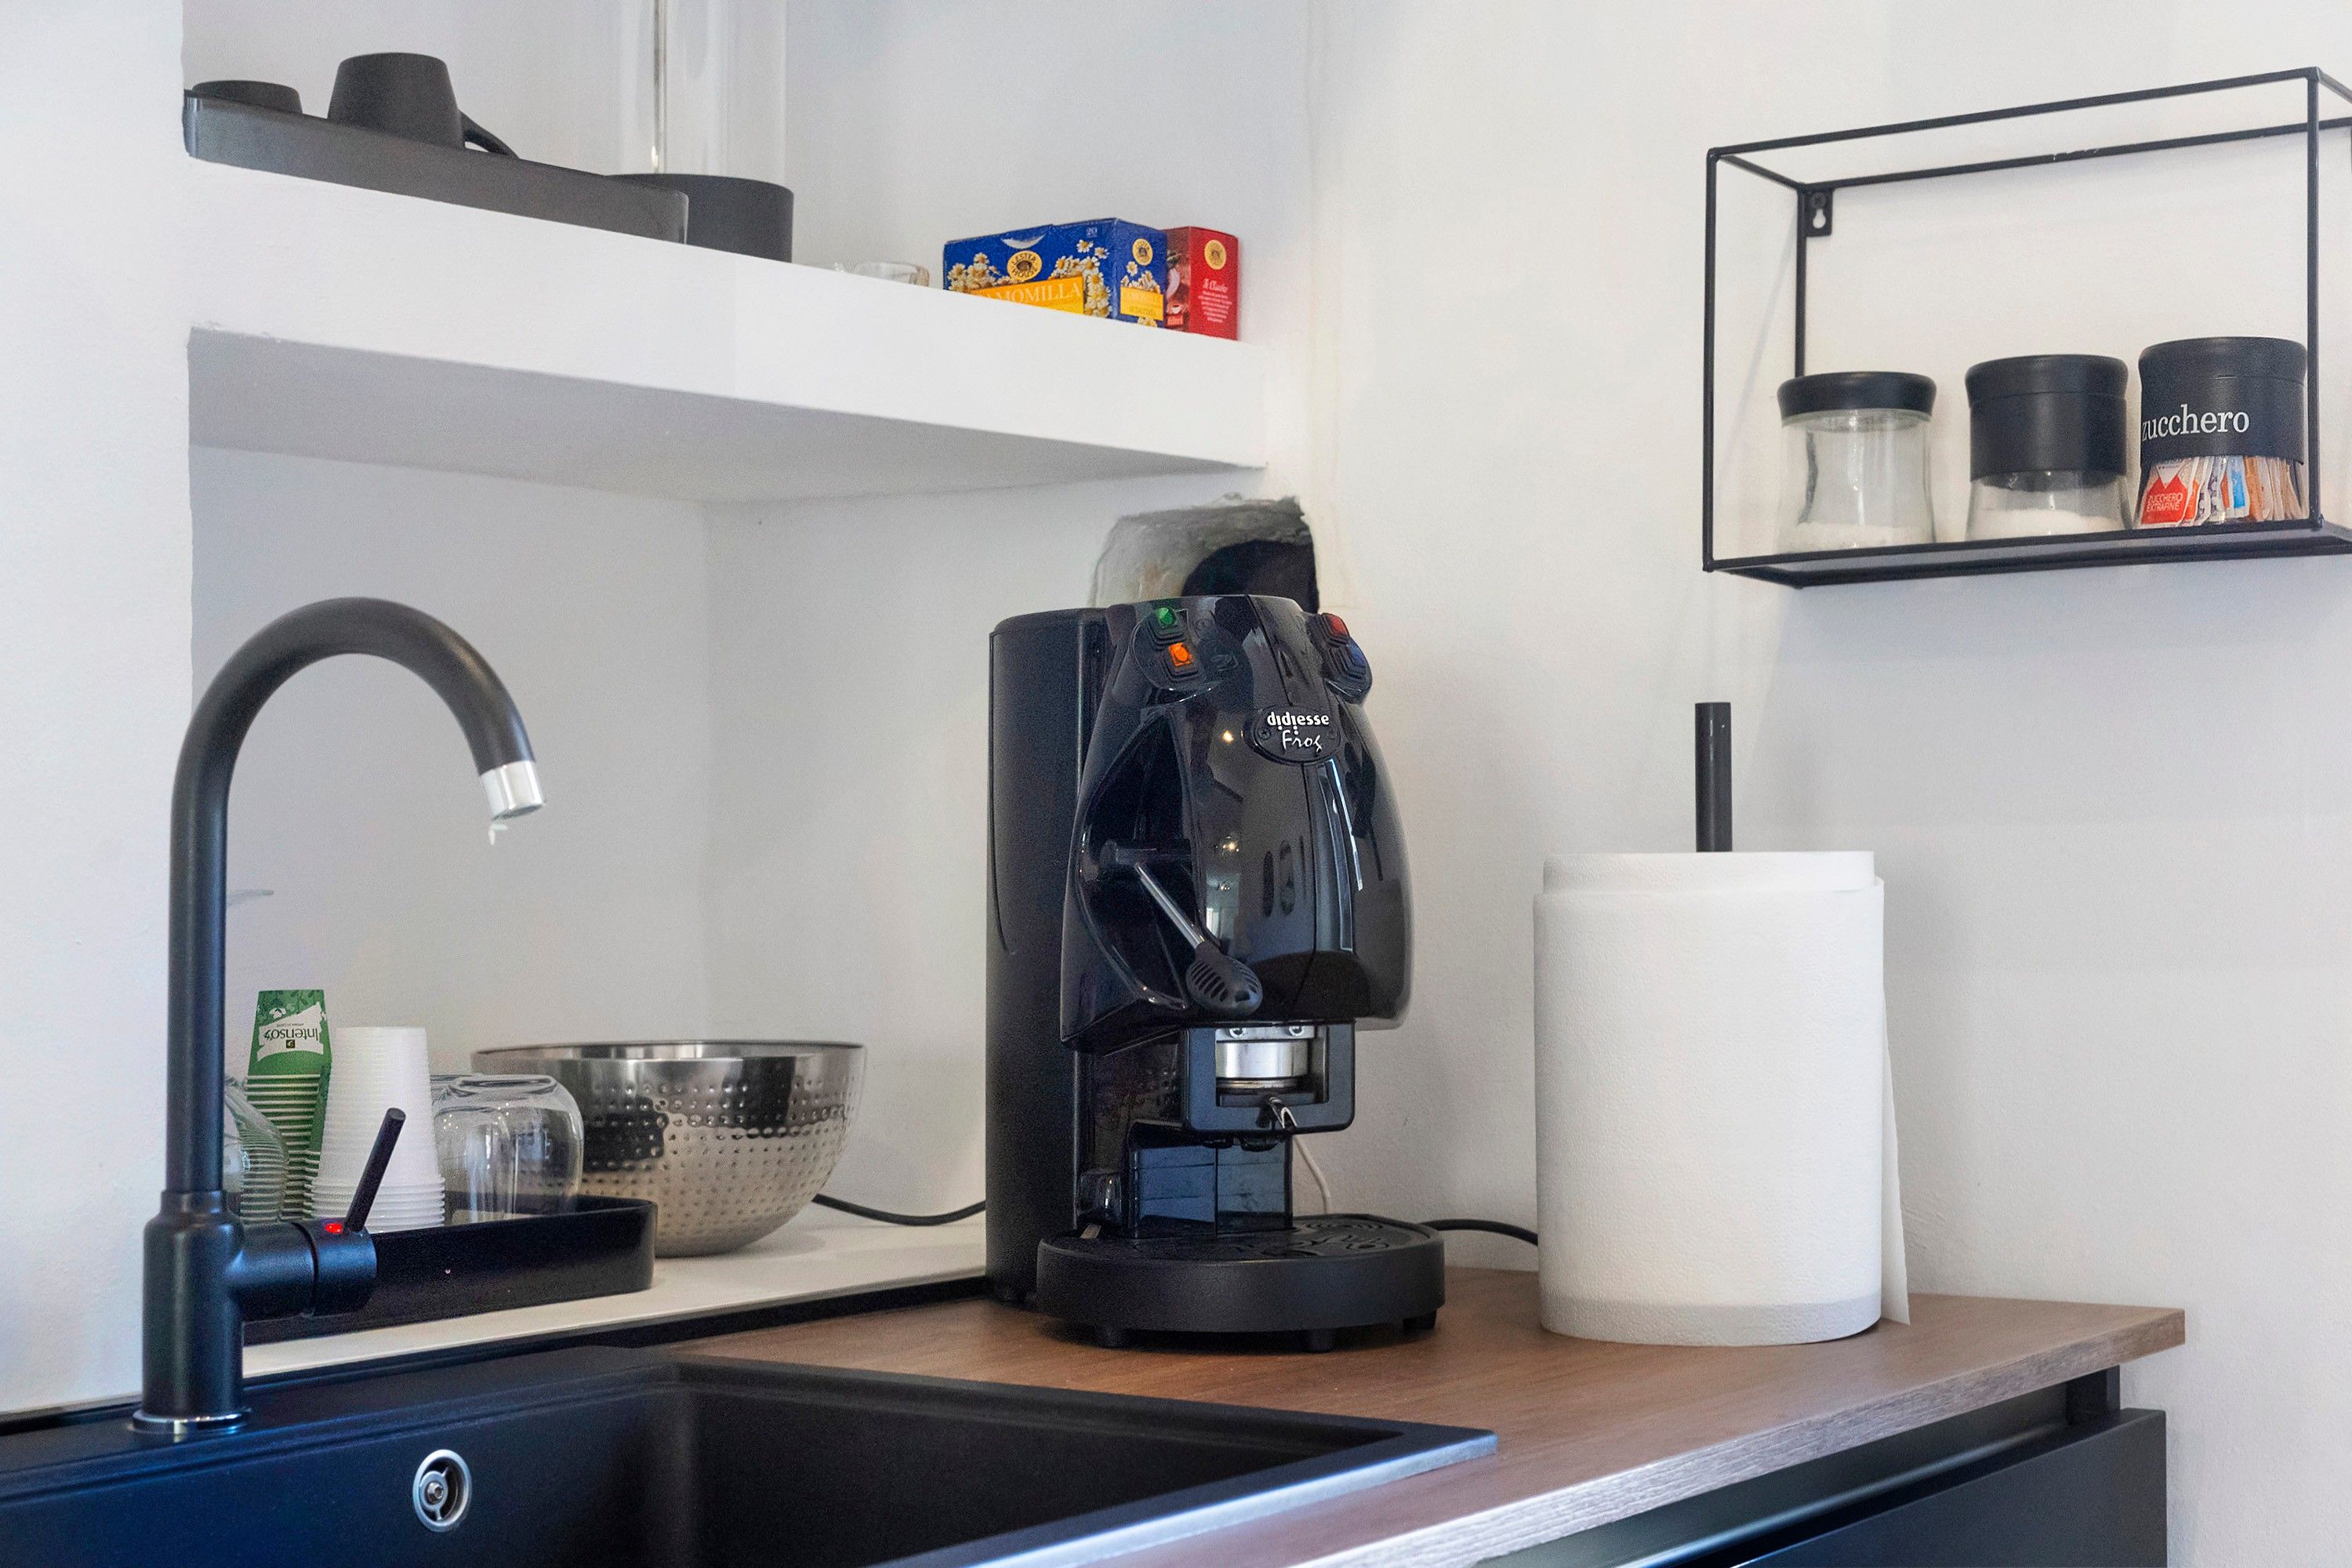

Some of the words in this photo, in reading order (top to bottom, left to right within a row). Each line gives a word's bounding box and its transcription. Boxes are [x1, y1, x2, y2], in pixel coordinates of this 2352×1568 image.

[2141, 404, 2250, 442] zucchero
[2148, 492, 2183, 503] ZUCCHERO
[2147, 503, 2180, 513] EXTRAFINE
[1267, 711, 1329, 730] didiesse
[1282, 730, 1323, 753] Frog
